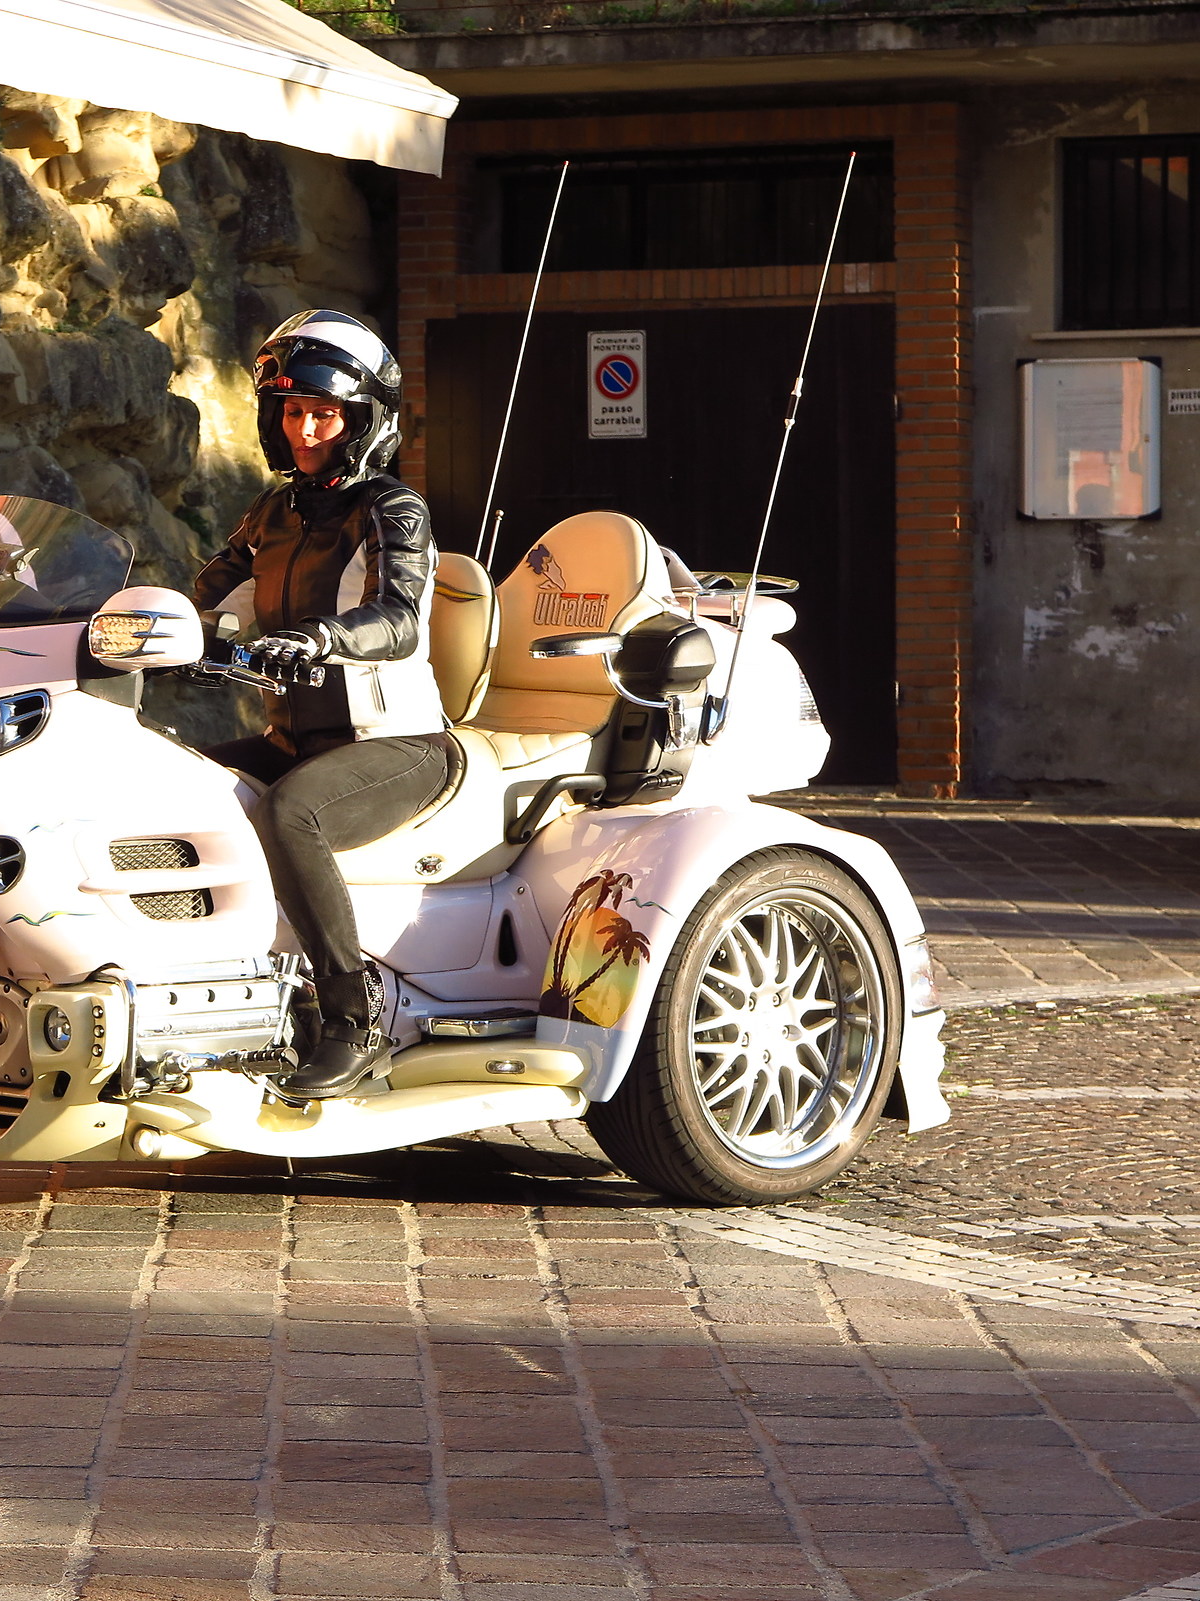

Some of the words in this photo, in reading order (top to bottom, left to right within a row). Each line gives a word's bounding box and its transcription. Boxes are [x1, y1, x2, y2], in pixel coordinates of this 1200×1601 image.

[593, 344, 641, 352] MONTEFINO
[601, 405, 633, 414] passo
[594, 416, 641, 425] carrabile
[533, 592, 608, 628] Ultratech
